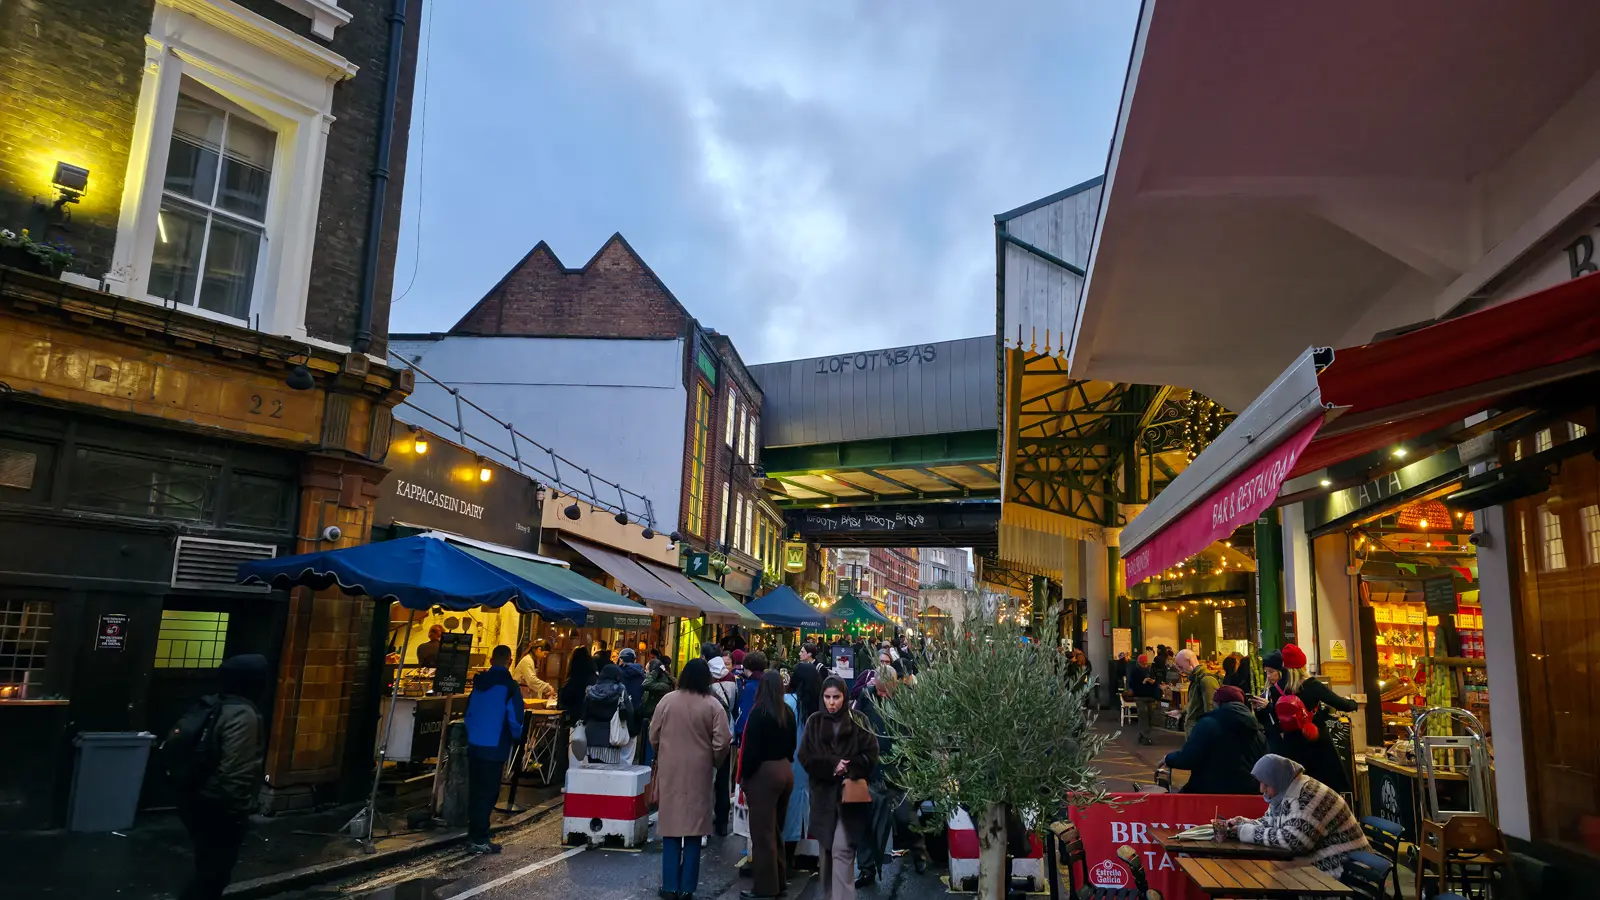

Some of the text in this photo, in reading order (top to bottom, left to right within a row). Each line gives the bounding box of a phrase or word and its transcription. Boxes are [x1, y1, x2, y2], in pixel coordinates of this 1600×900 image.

[249, 394, 284, 419] 22
[396, 480, 484, 519] KAPPACASEIN DAIRY
[1341, 471, 1402, 512] RAYA
[841, 515, 861, 527] BAS!
[1212, 497, 1229, 529] BAR
[1229, 492, 1236, 519] &
[1095, 868, 1122, 877] Estrella
[1096, 875, 1122, 884] Galicia
